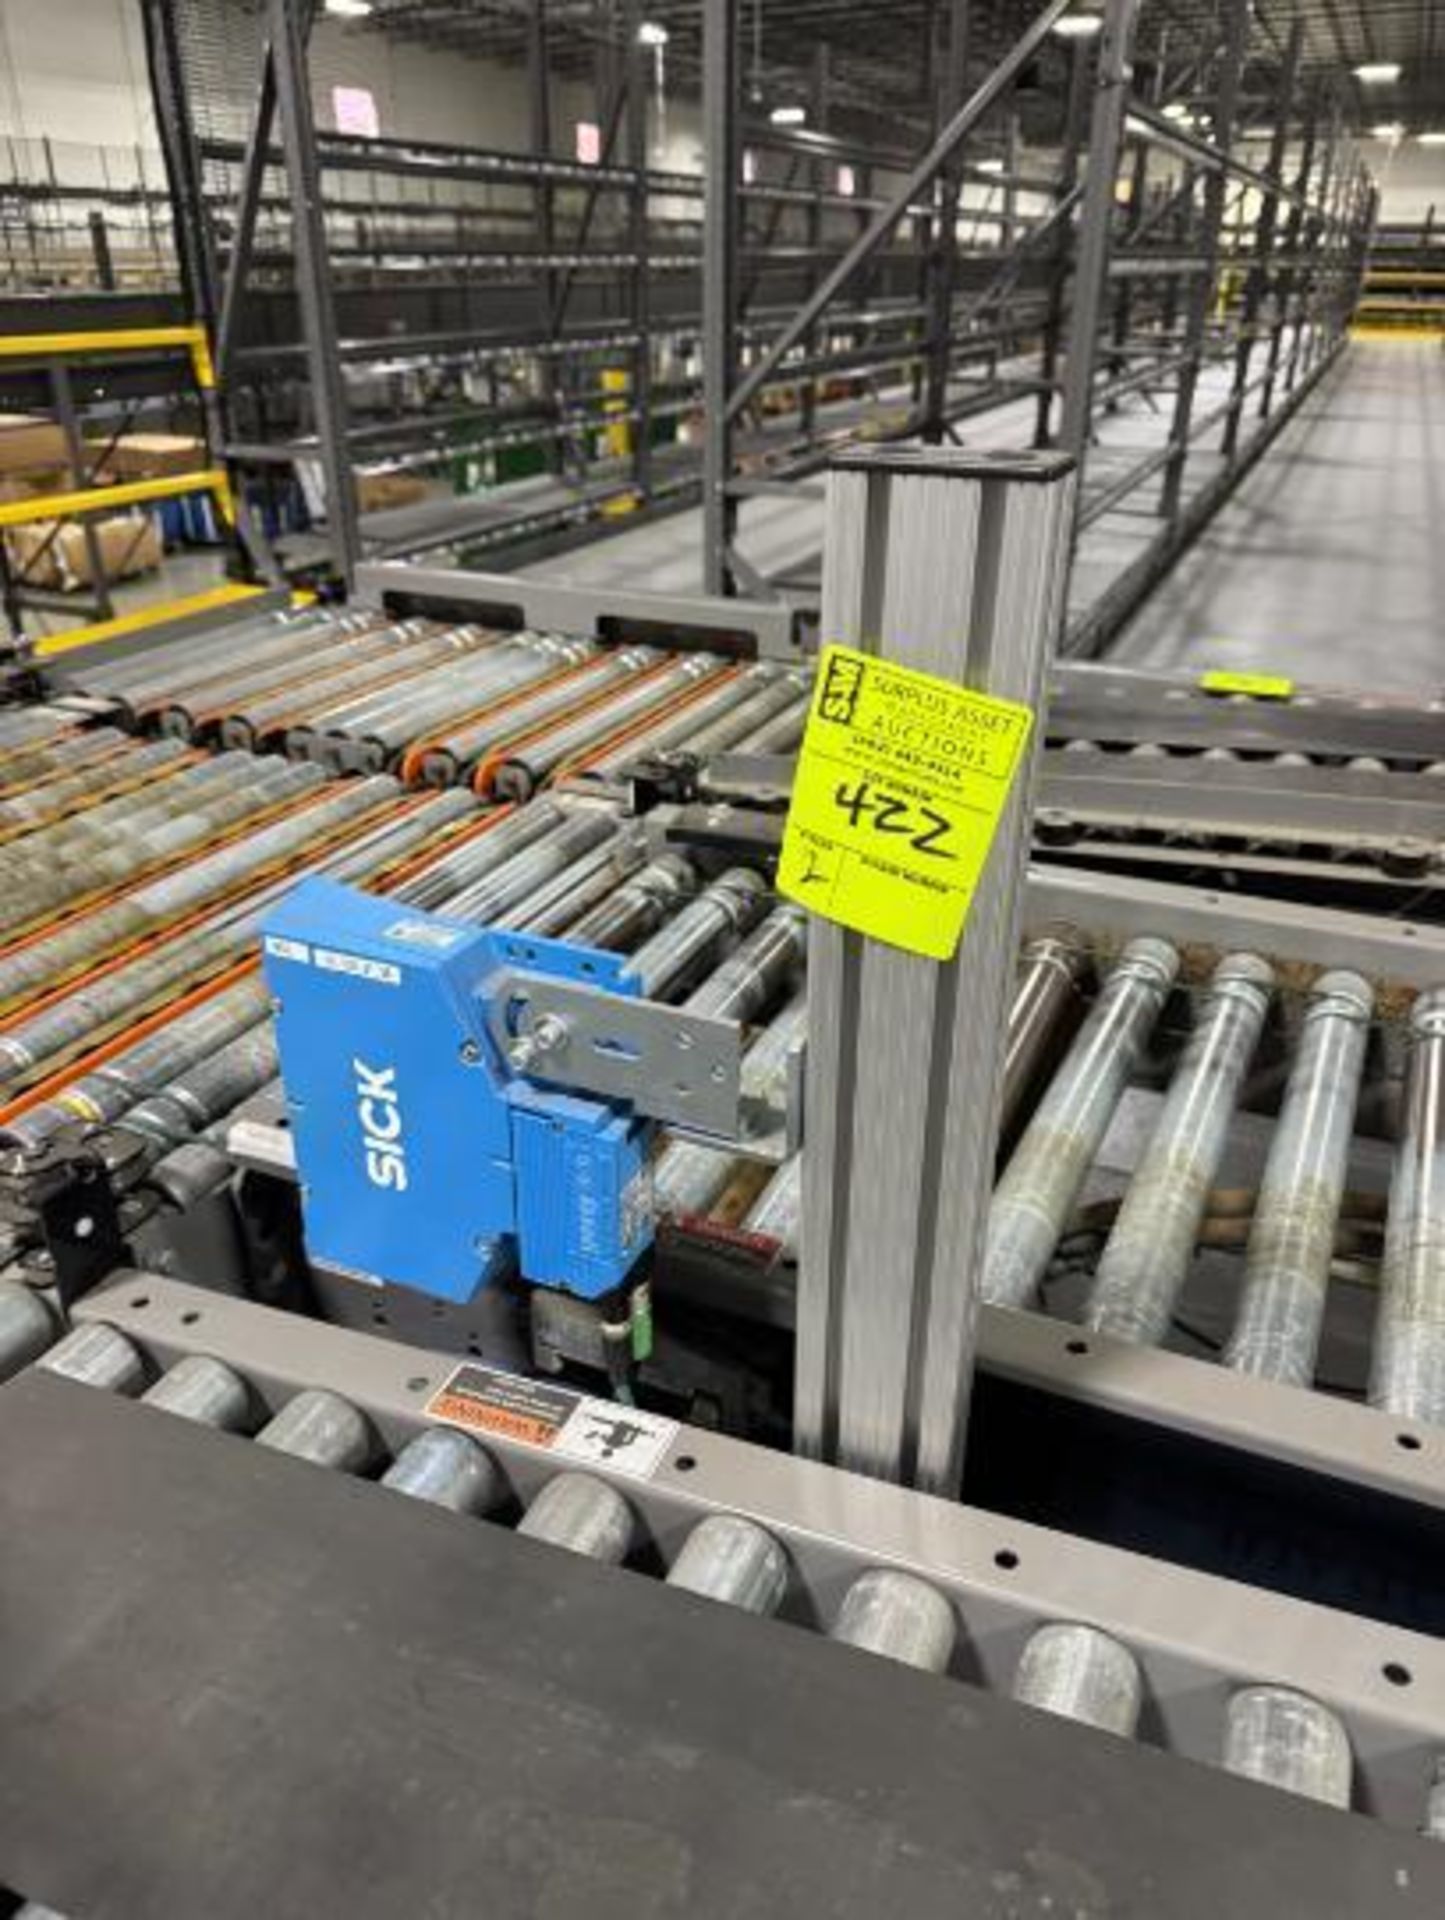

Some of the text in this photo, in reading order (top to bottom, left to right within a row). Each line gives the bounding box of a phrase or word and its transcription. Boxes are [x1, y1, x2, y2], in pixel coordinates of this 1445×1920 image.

[874, 675, 948, 717] SURPLUS
[952, 706, 1012, 732] ASSET
[874, 715, 987, 765] AUCTIONS
[835, 783, 958, 860] 422
[353, 1058, 408, 1192] SICK
